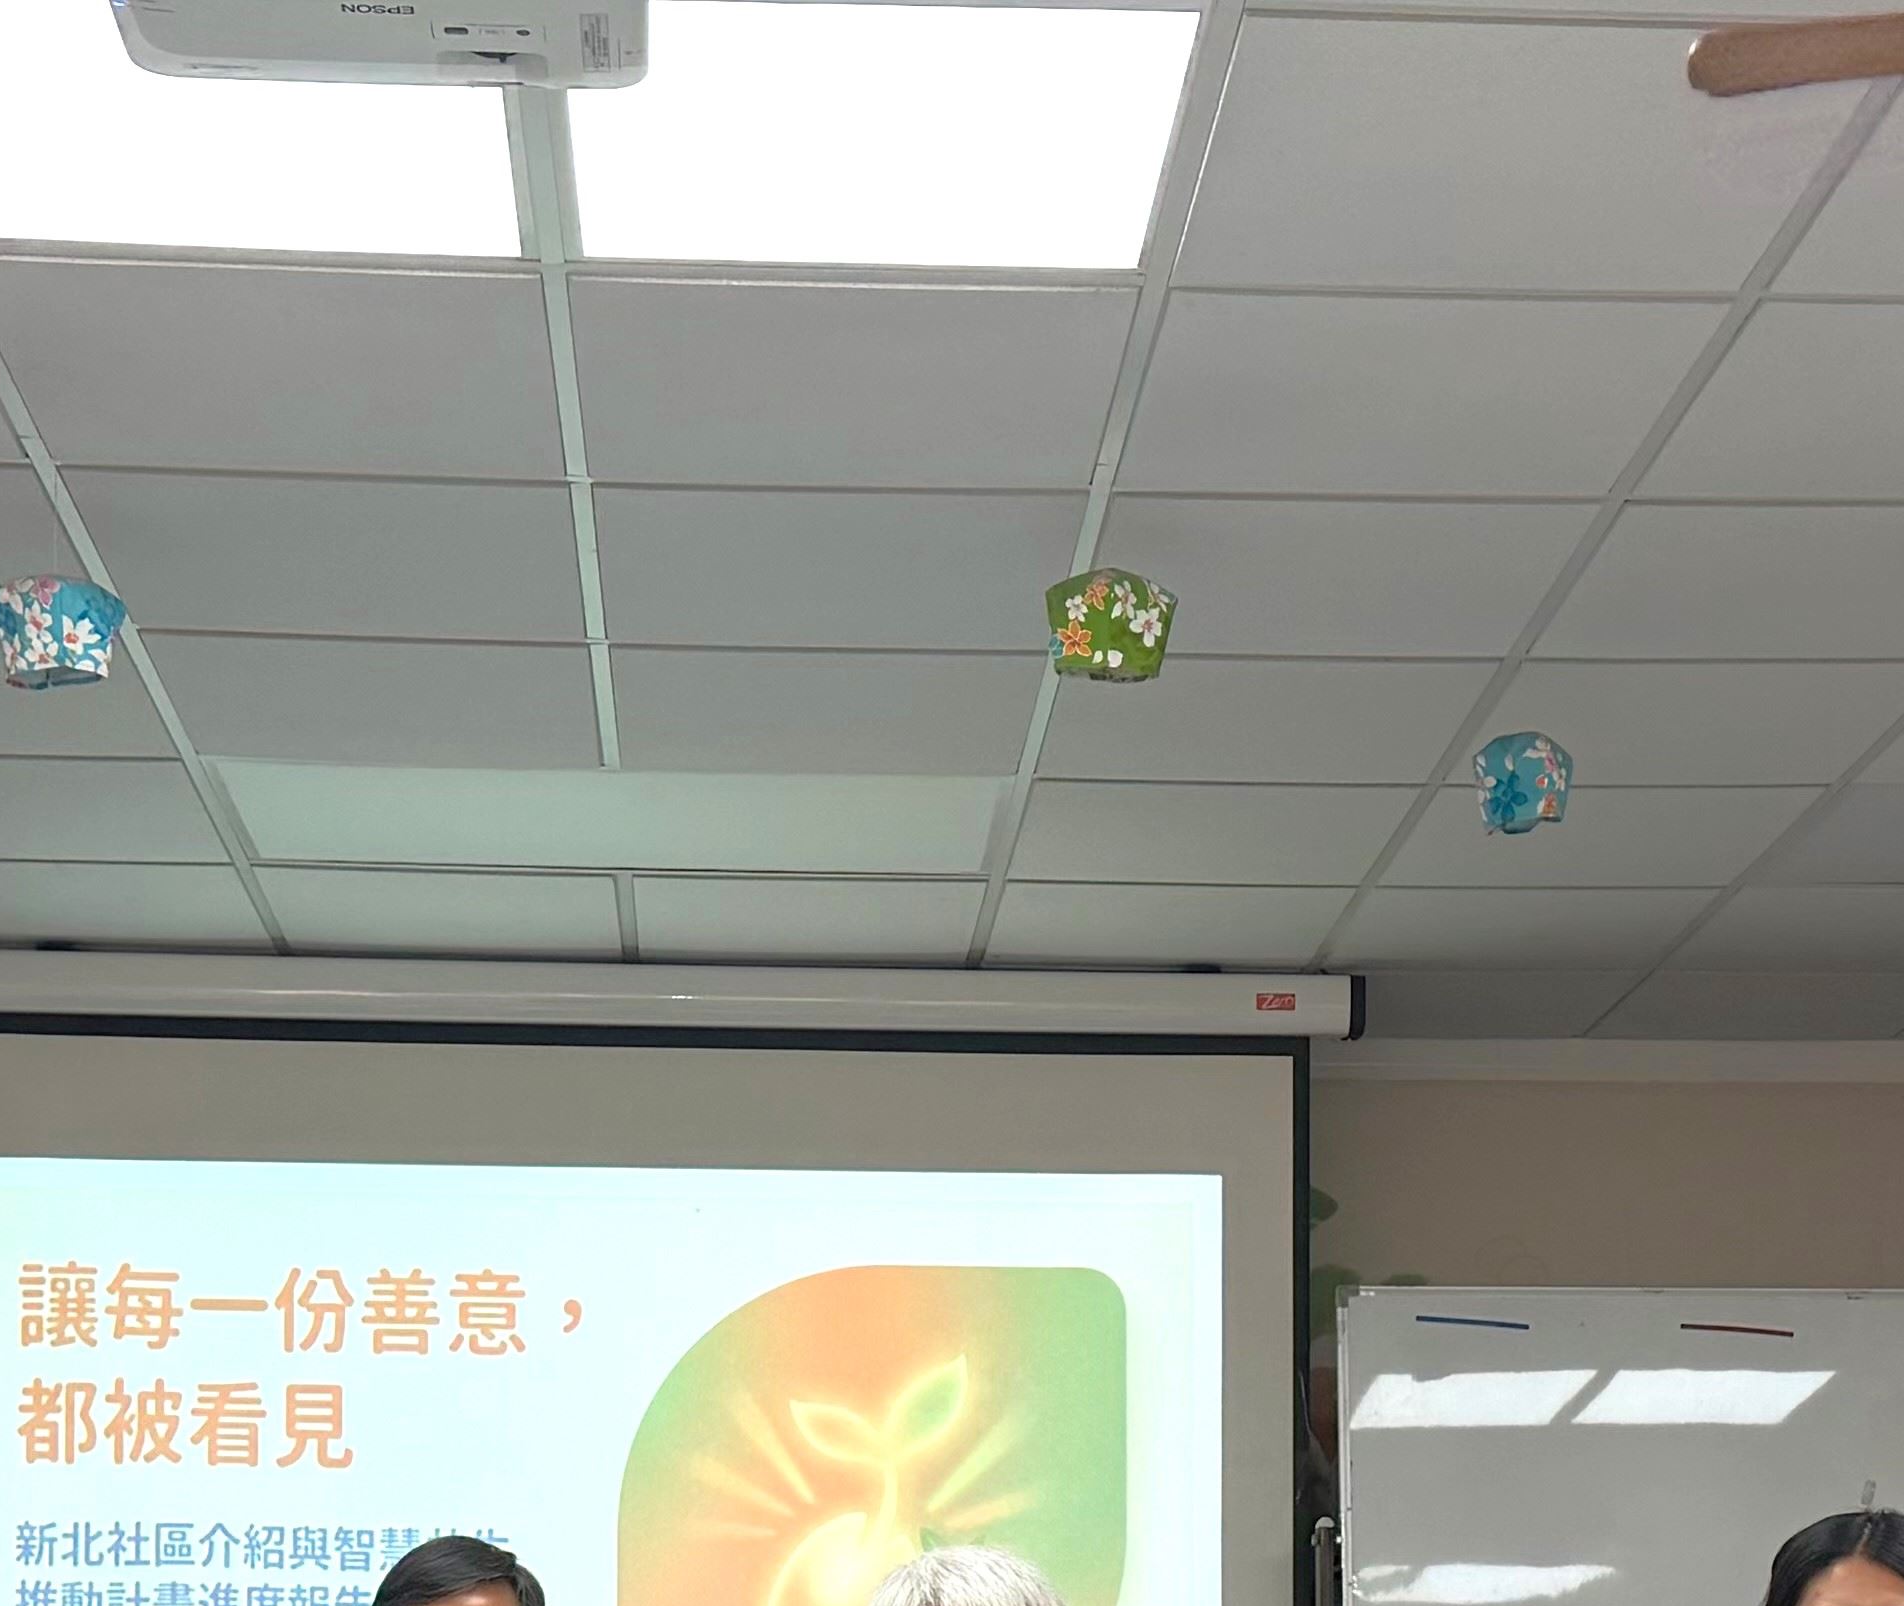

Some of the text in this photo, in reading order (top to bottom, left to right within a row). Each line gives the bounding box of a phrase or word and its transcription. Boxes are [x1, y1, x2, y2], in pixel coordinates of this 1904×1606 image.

[341, 4, 415, 15] EPSON
[18, 1261, 585, 1355] 讓每一份善意，
[18, 1377, 354, 1470] 都被看見
[15, 1520, 509, 1573] 新北社區介紹與智慧
